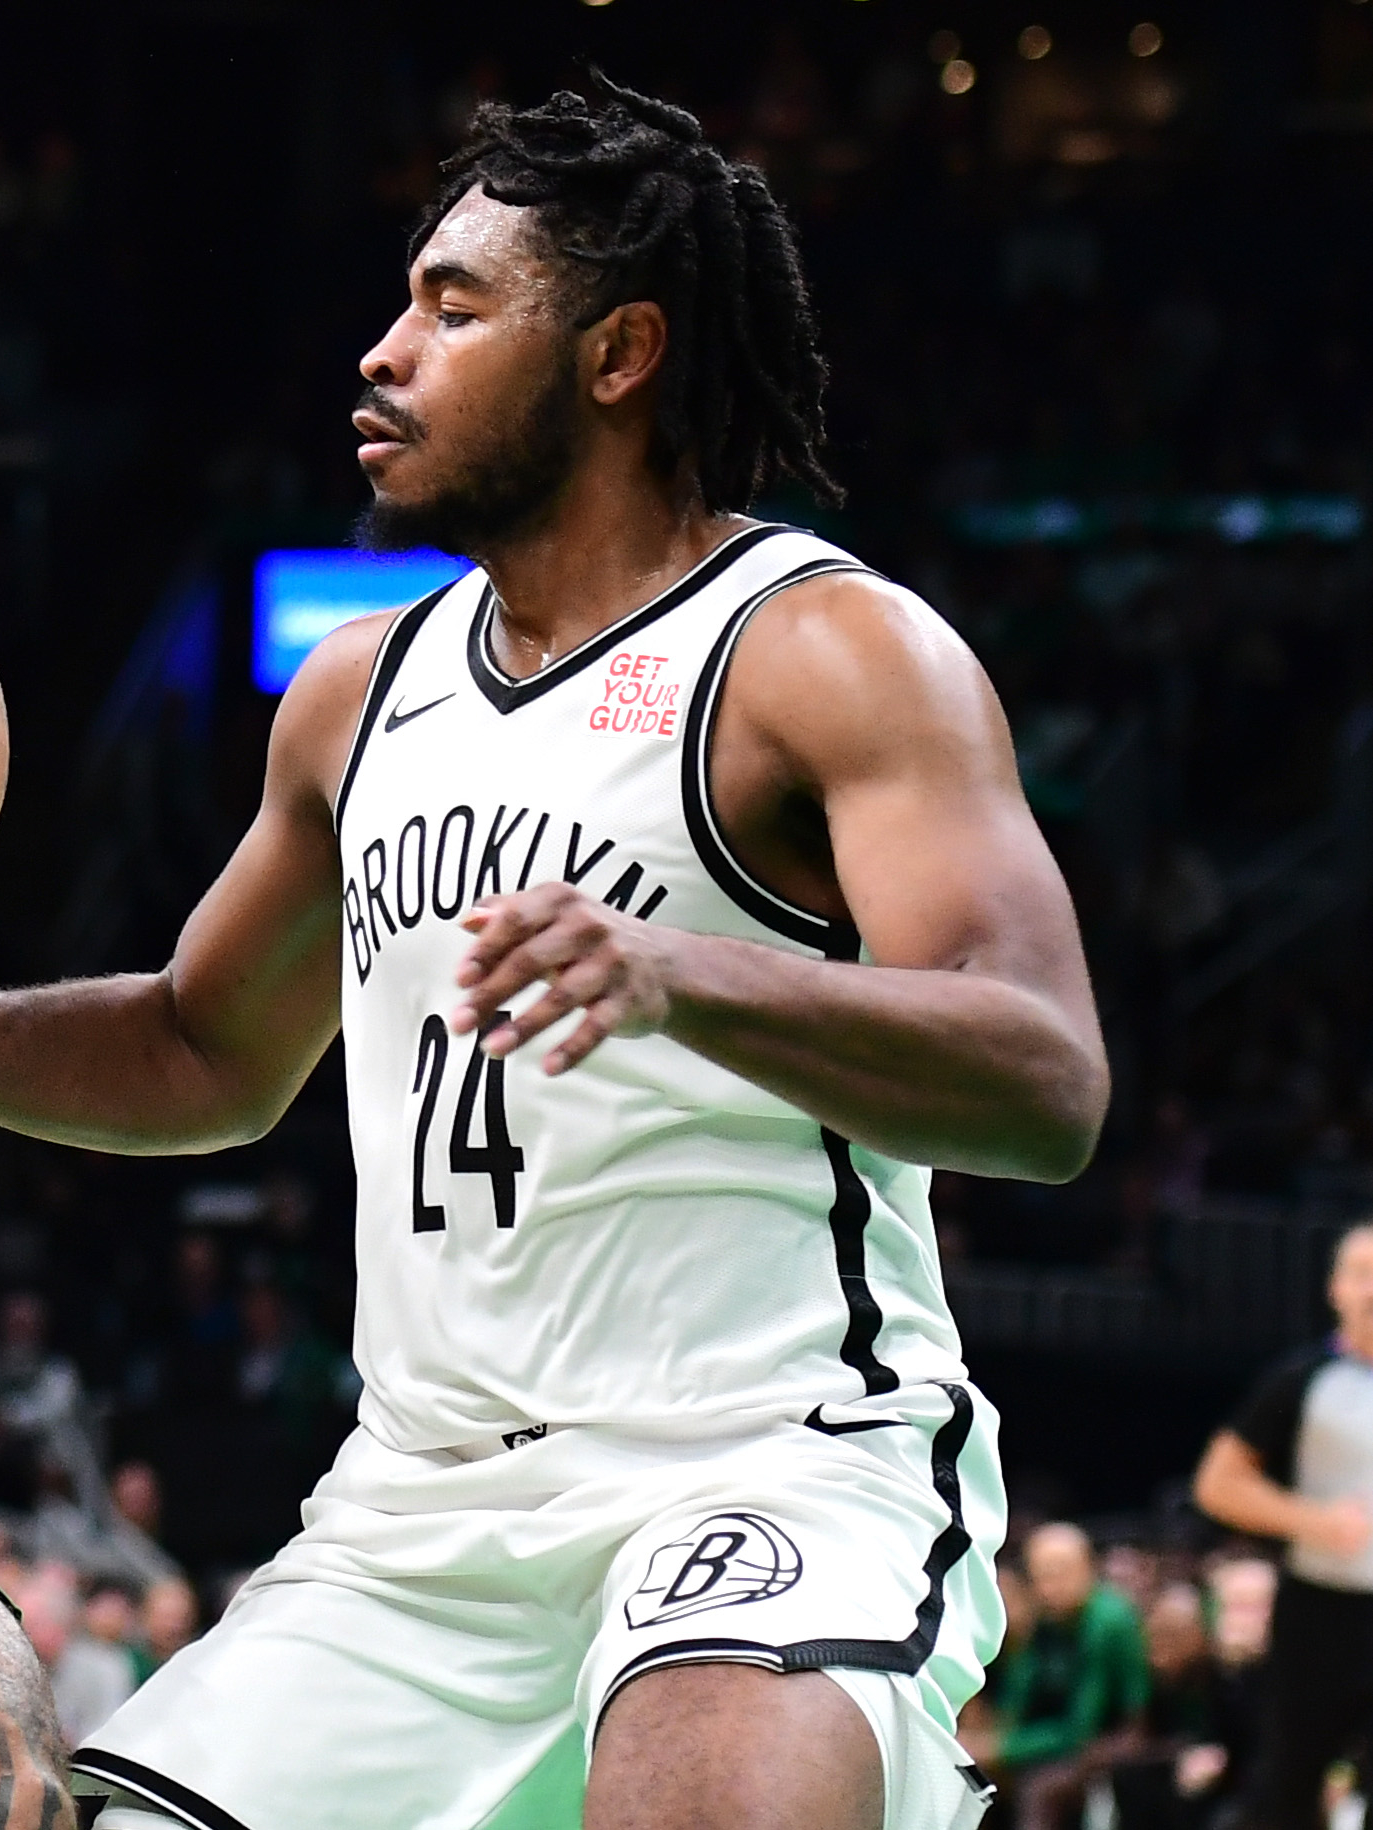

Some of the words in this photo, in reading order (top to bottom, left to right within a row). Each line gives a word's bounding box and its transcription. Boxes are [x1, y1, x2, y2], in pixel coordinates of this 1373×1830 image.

[609, 653, 669, 680] GET
[603, 679, 680, 707] YOUR
[589, 705, 677, 736] GUIDE
[412, 1011, 525, 1233] 24
